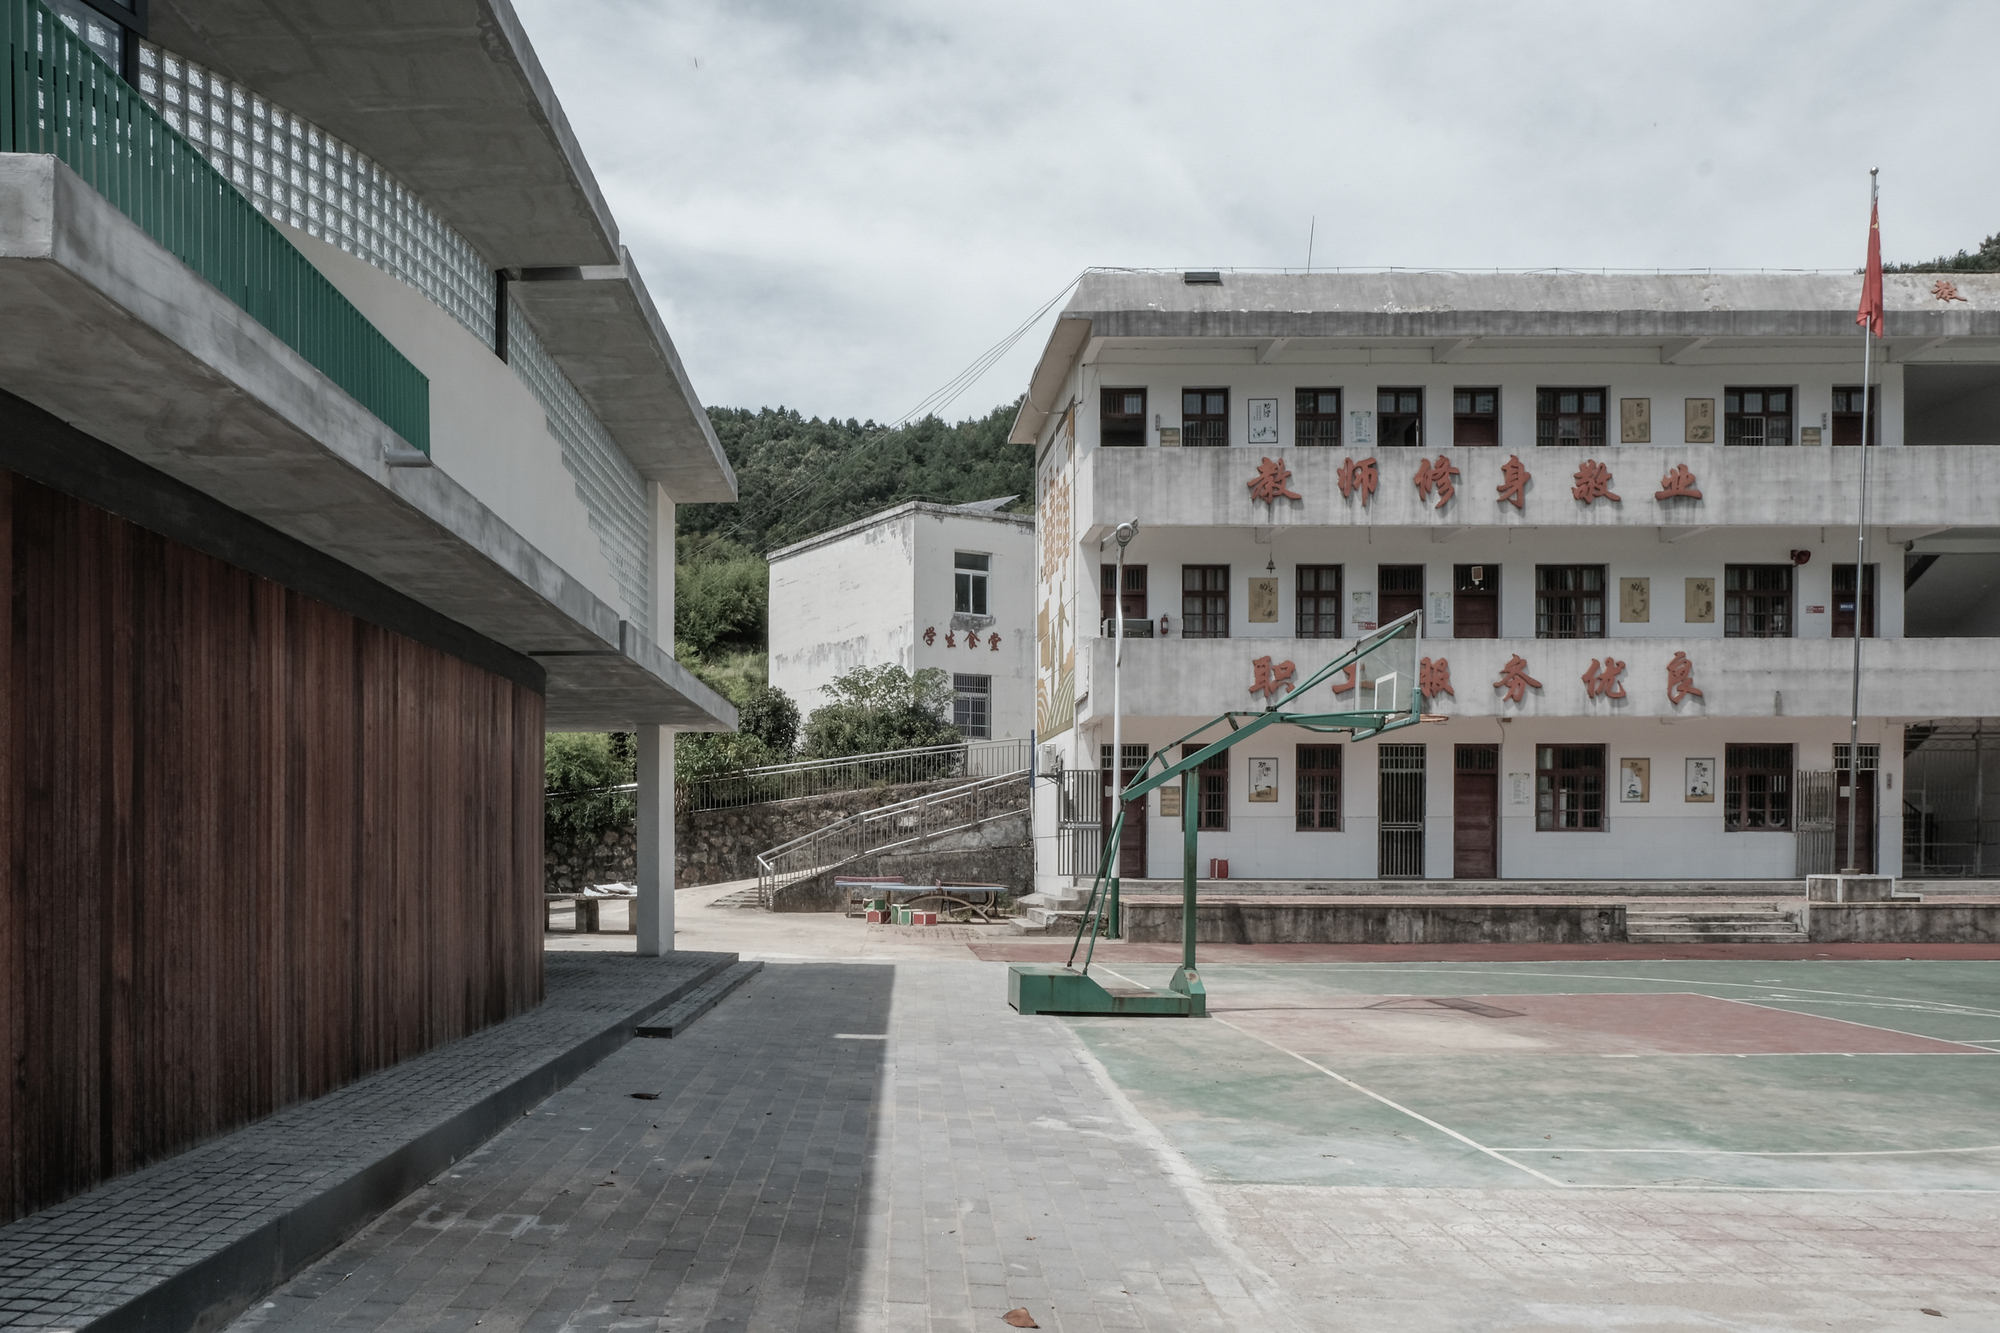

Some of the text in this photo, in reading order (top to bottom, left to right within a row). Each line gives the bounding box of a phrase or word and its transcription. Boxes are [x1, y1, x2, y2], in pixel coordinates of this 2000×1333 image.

[1247, 455, 1703, 509] 教师修身敬业
[922, 626, 1002, 652] 学生食堂
[1248, 651, 1703, 705] 职工服务优良
